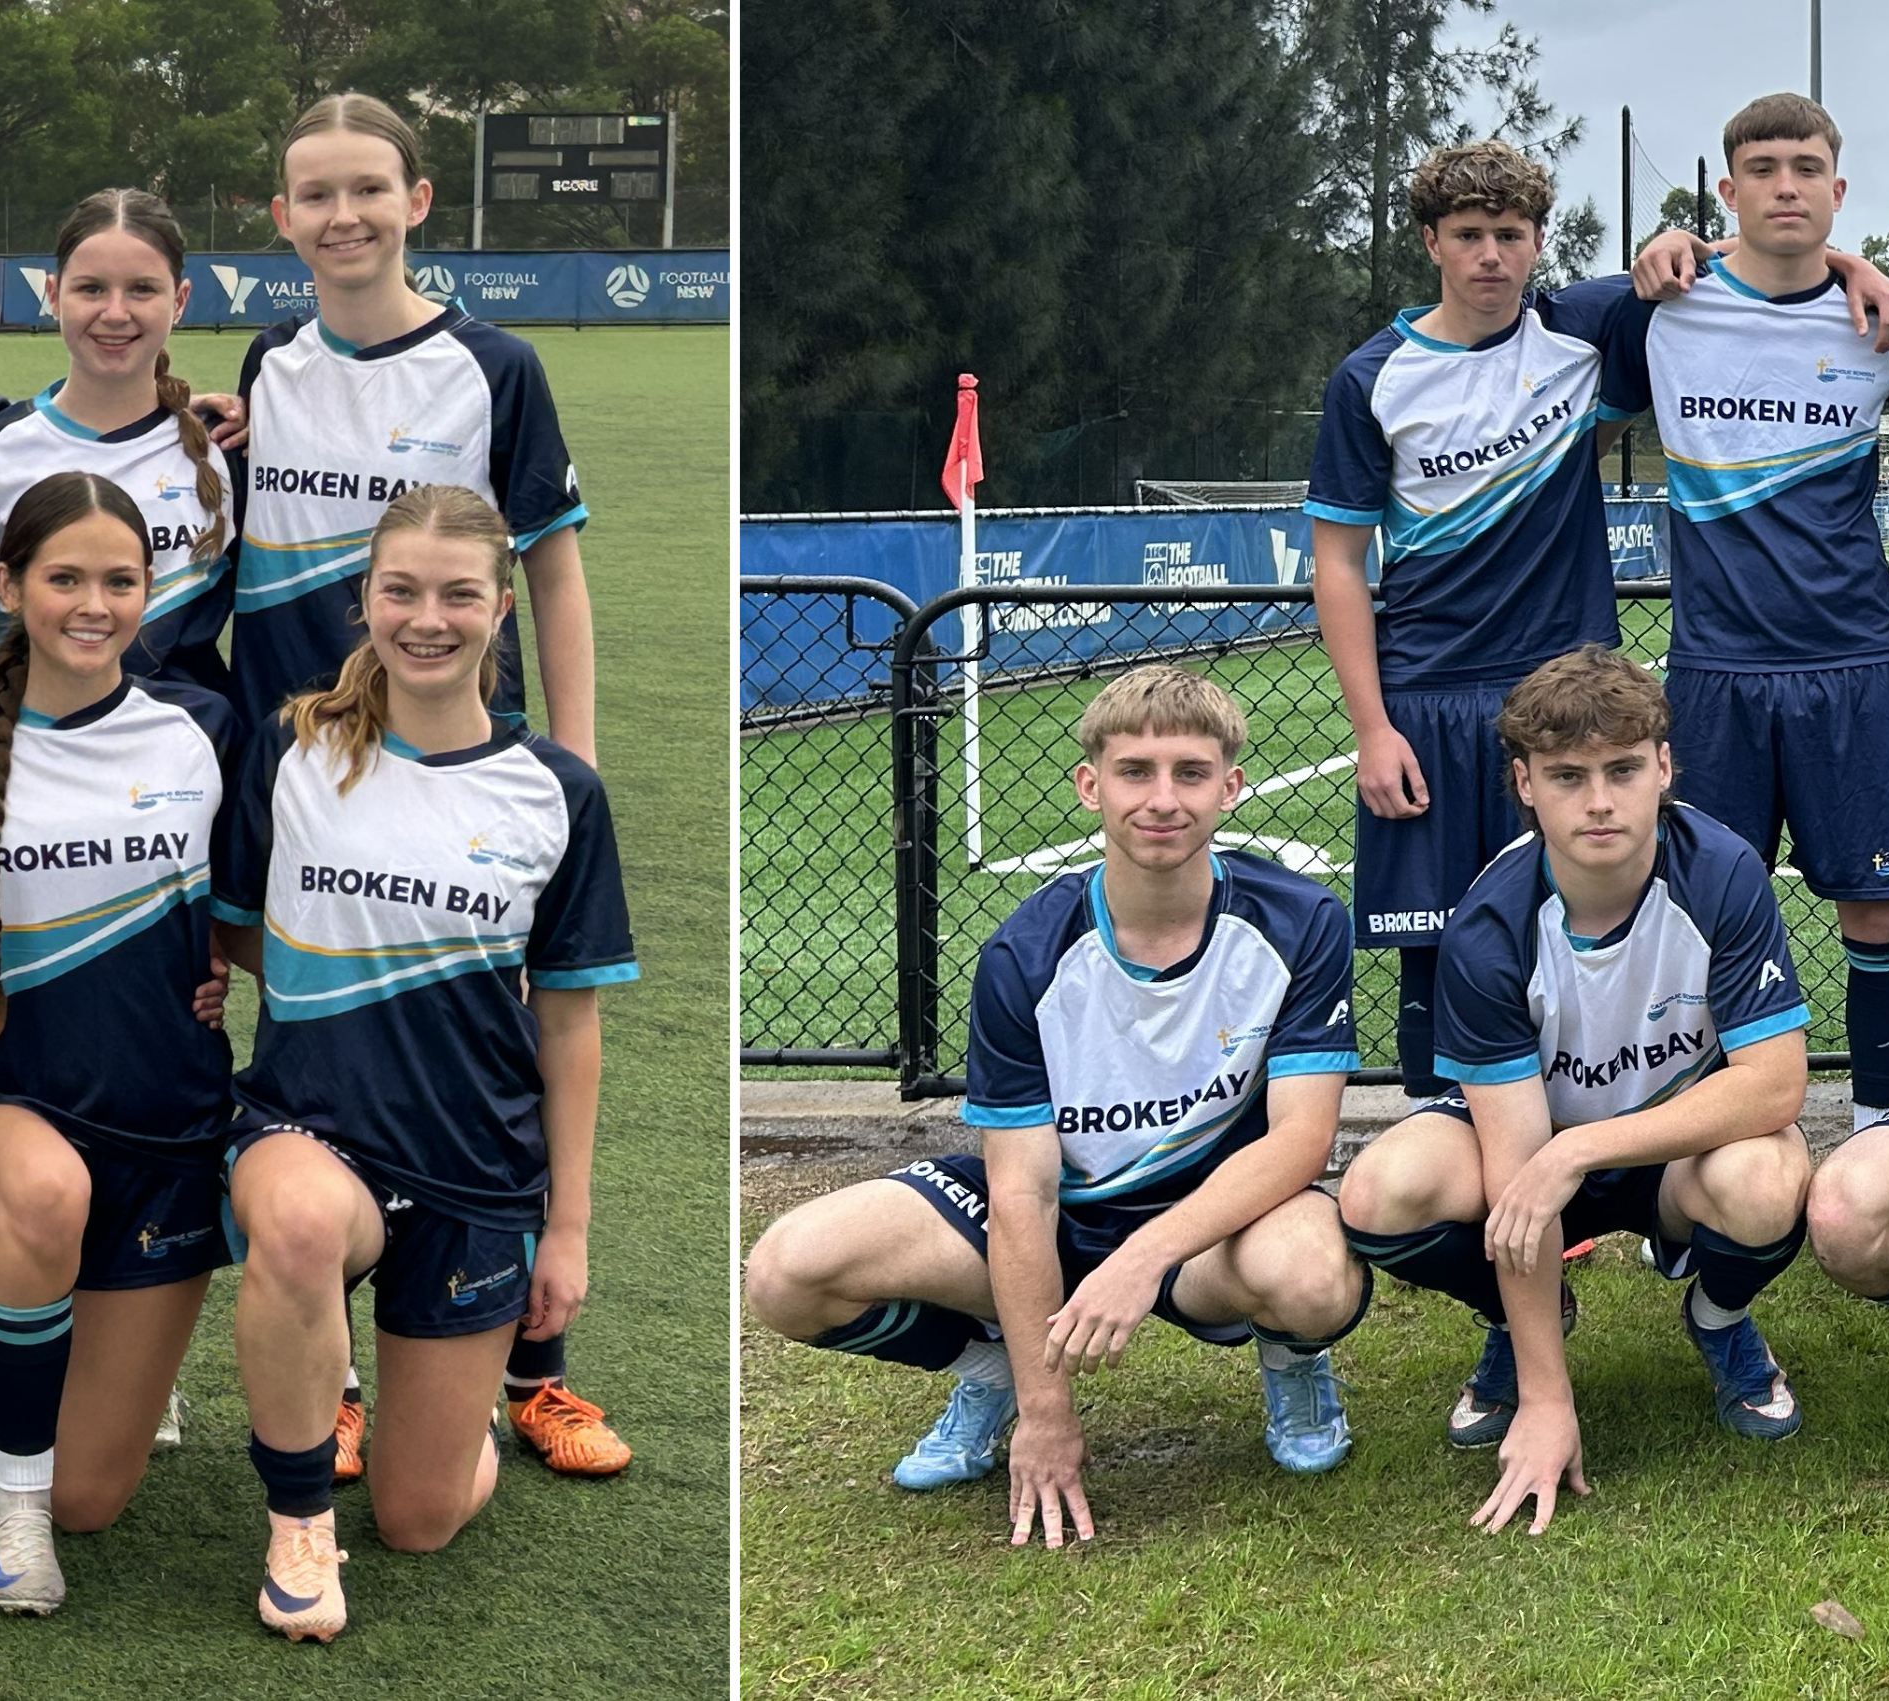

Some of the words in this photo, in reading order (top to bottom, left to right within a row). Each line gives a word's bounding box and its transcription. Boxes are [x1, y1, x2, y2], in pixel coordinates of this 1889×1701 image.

[552, 179, 599, 192] SCORE
[265, 281, 316, 297] VALE
[464, 272, 539, 286] FOOTBALL
[481, 286, 521, 300] NSW
[676, 285, 715, 299] NSW
[1679, 396, 1796, 424] BROKEN
[1804, 403, 1859, 428] BAY
[1418, 430, 1528, 479] BROKEN
[255, 465, 360, 500] BROKEN
[368, 475, 419, 503] BA
[993, 551, 1022, 577] THE
[1169, 542, 1192, 566] THE
[1168, 564, 1229, 586] FOOTBALL
[124, 832, 189, 864] BAY
[299, 865, 437, 907] BROKEN
[445, 885, 511, 925] BAY
[1369, 910, 1446, 933] BROKEN
[1644, 1028, 1705, 1071] BAY
[1202, 1069, 1252, 1104] AY
